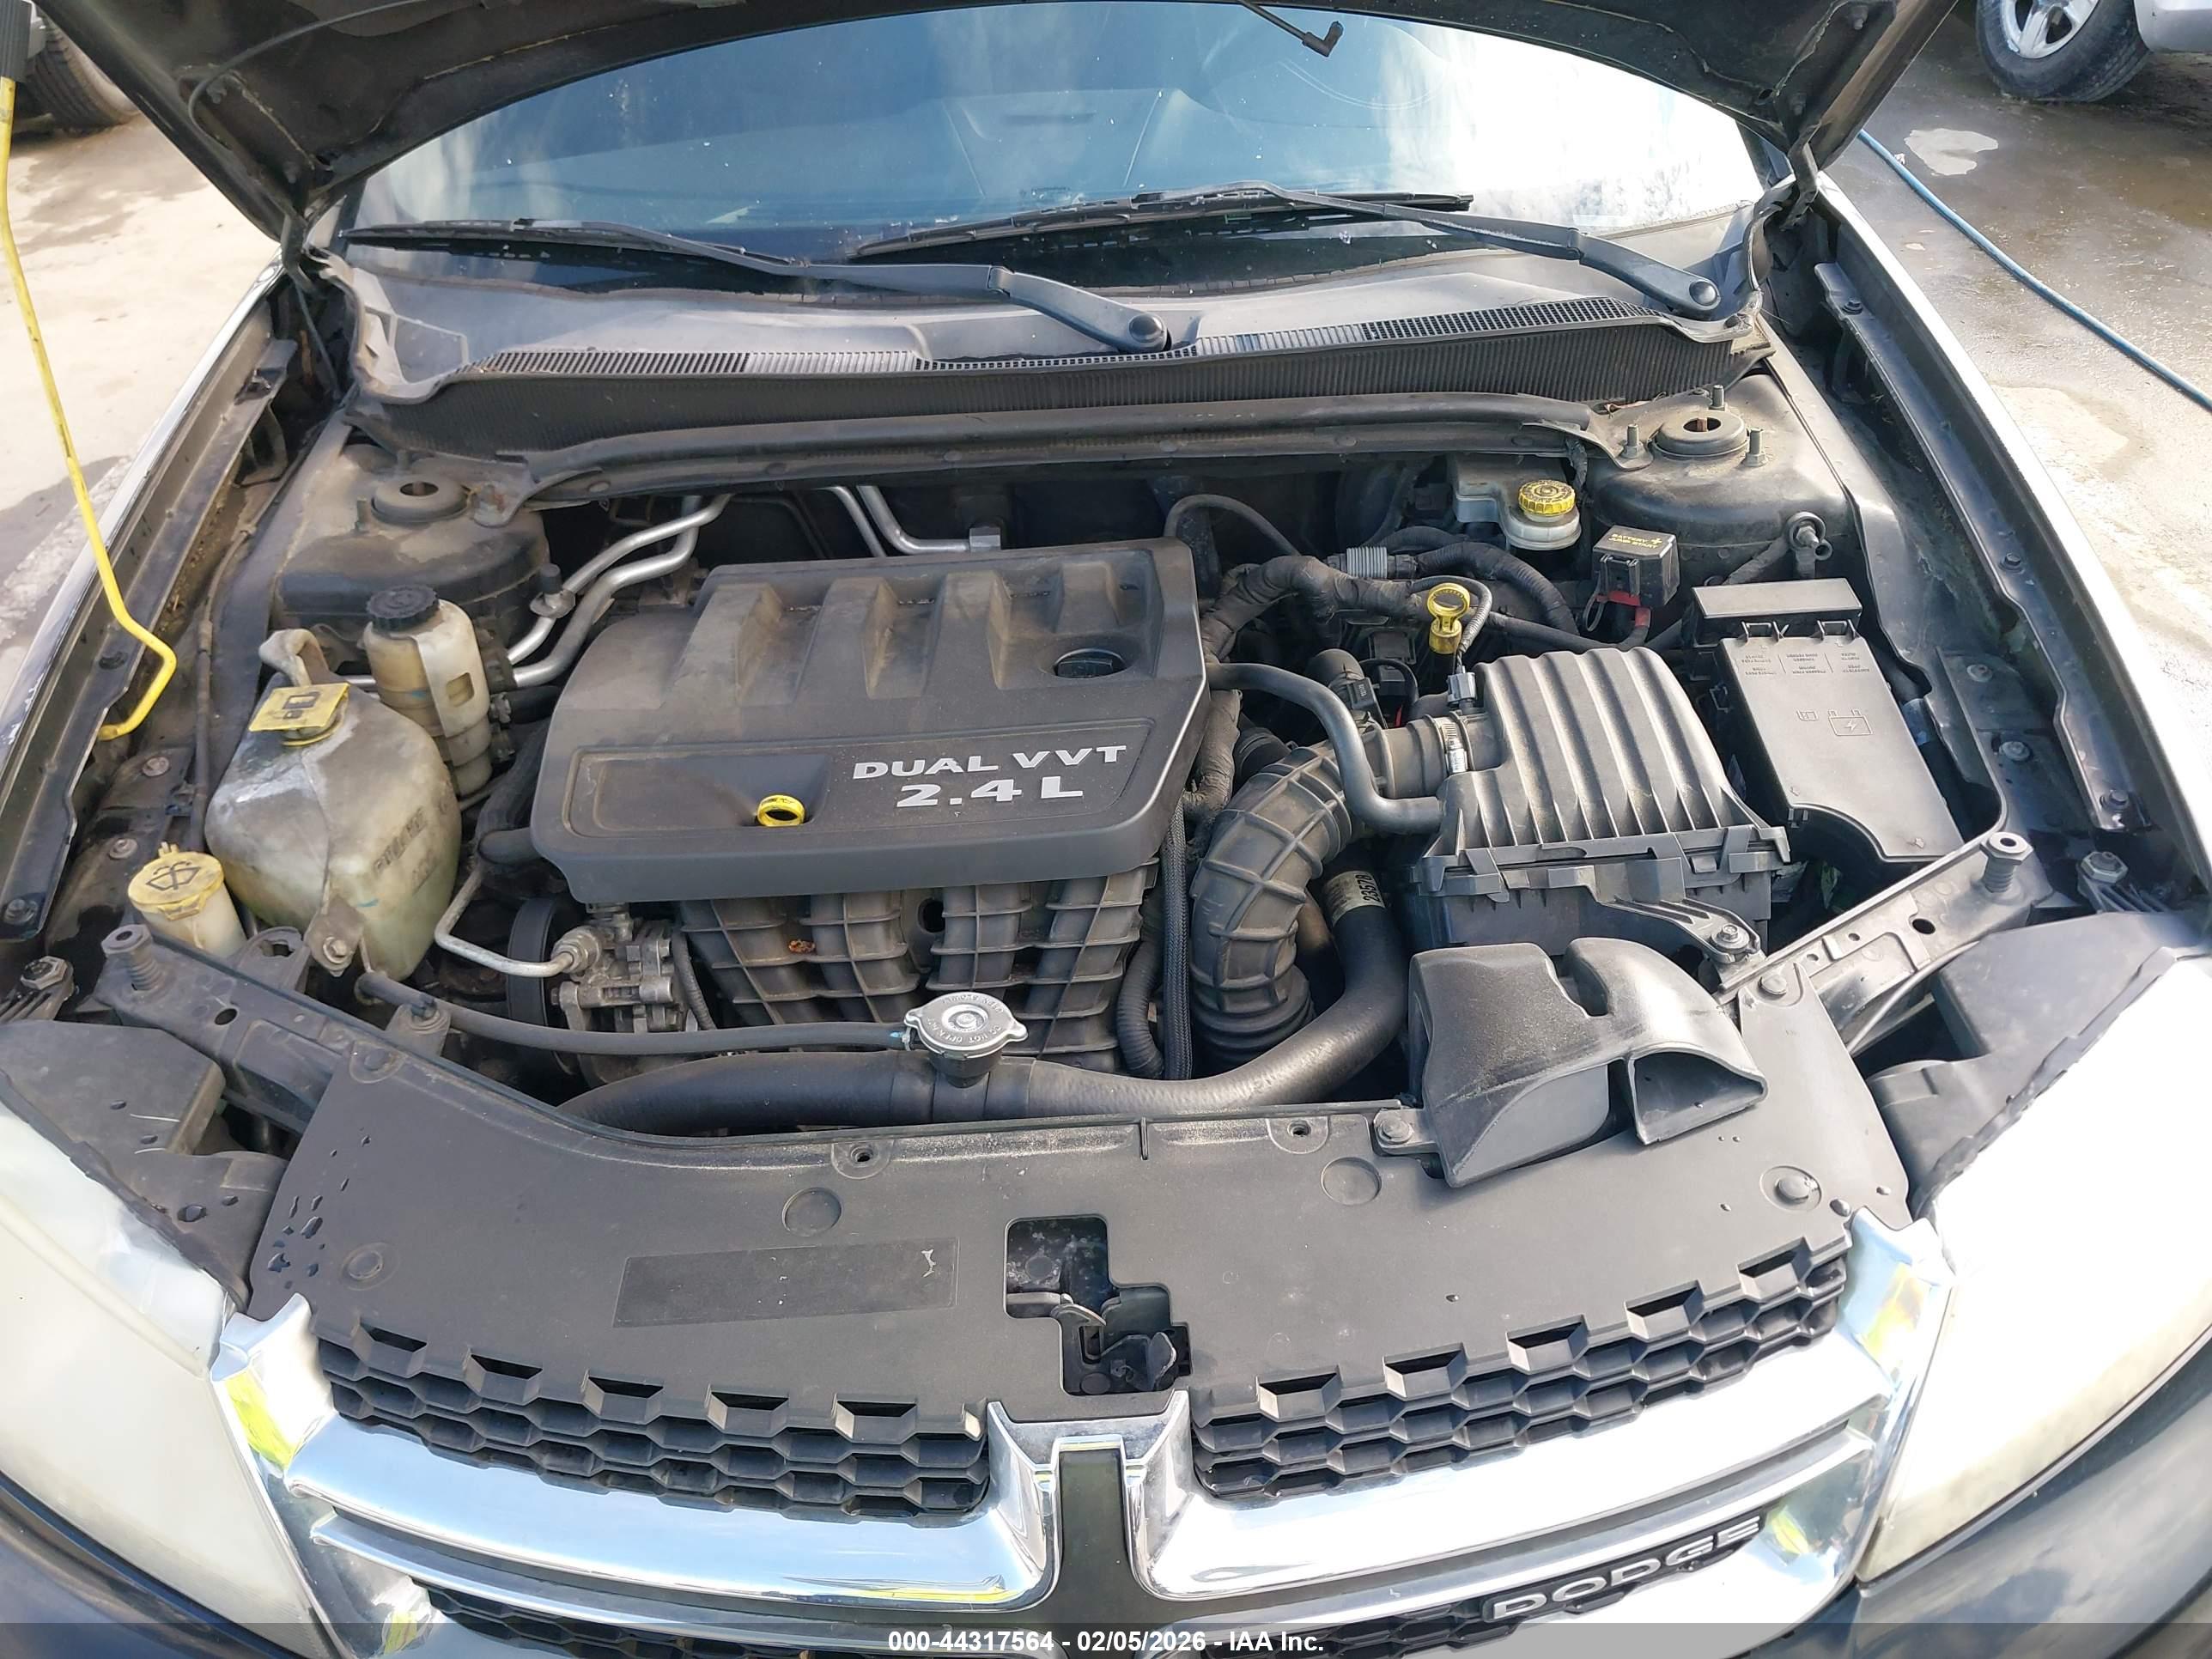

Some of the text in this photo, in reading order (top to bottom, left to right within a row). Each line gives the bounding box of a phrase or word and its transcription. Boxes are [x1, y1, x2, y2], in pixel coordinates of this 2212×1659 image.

[853, 744, 1127, 779] DUAL VVT
[1355, 874, 1382, 902] 23578
[939, 1030, 963, 1043] OPEN
[969, 1033, 988, 1043] NOT
[1492, 1516, 1760, 1620] DODGE
